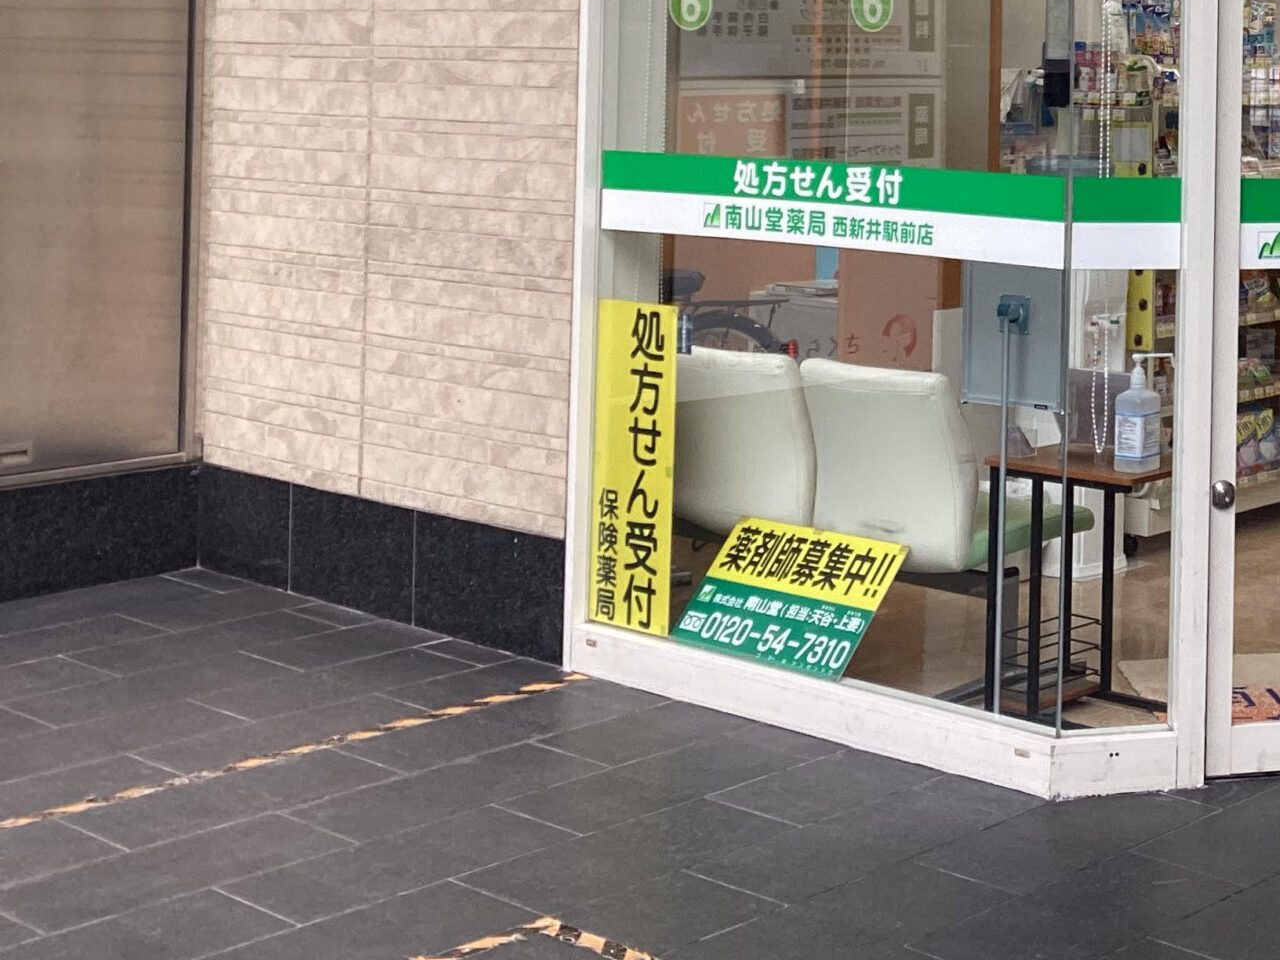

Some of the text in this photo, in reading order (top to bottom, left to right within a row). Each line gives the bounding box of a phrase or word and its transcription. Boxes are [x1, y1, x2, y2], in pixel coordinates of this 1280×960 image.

[733, 159, 903, 205] 処方せん受付
[725, 204, 934, 246] 南山堂薬局 西新井駅前店
[622, 307, 665, 630] 処方せん受付
[594, 487, 619, 623] 保険薬局
[712, 592, 744, 610] 株式会社
[700, 611, 852, 670] 0120-54-7310
